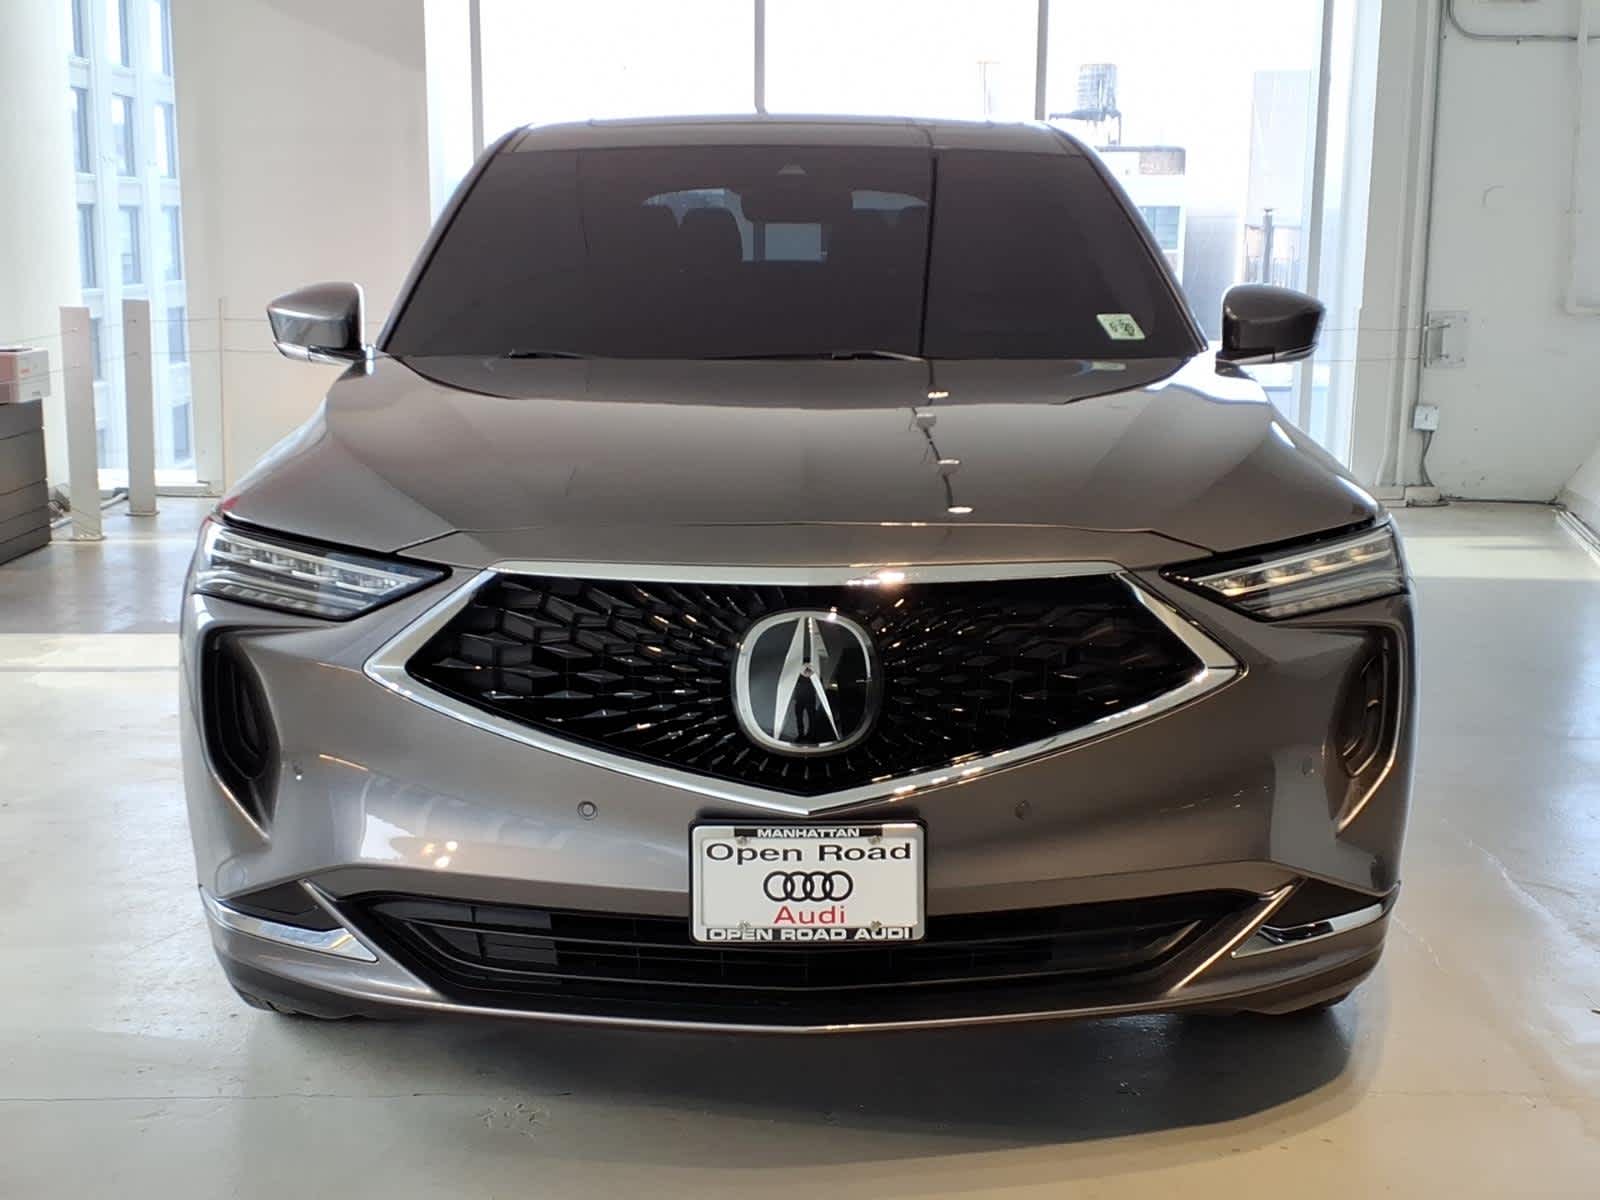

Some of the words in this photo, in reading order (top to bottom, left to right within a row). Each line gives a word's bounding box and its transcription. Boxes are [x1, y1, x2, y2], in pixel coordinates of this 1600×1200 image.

[757, 828, 860, 838] MANHATTAN
[706, 843, 802, 865] Open
[818, 843, 911, 862] Road
[773, 905, 846, 924] Audi
[708, 928, 773, 941] OPEN
[780, 928, 847, 941] ROAD
[854, 927, 910, 940] AUDI
